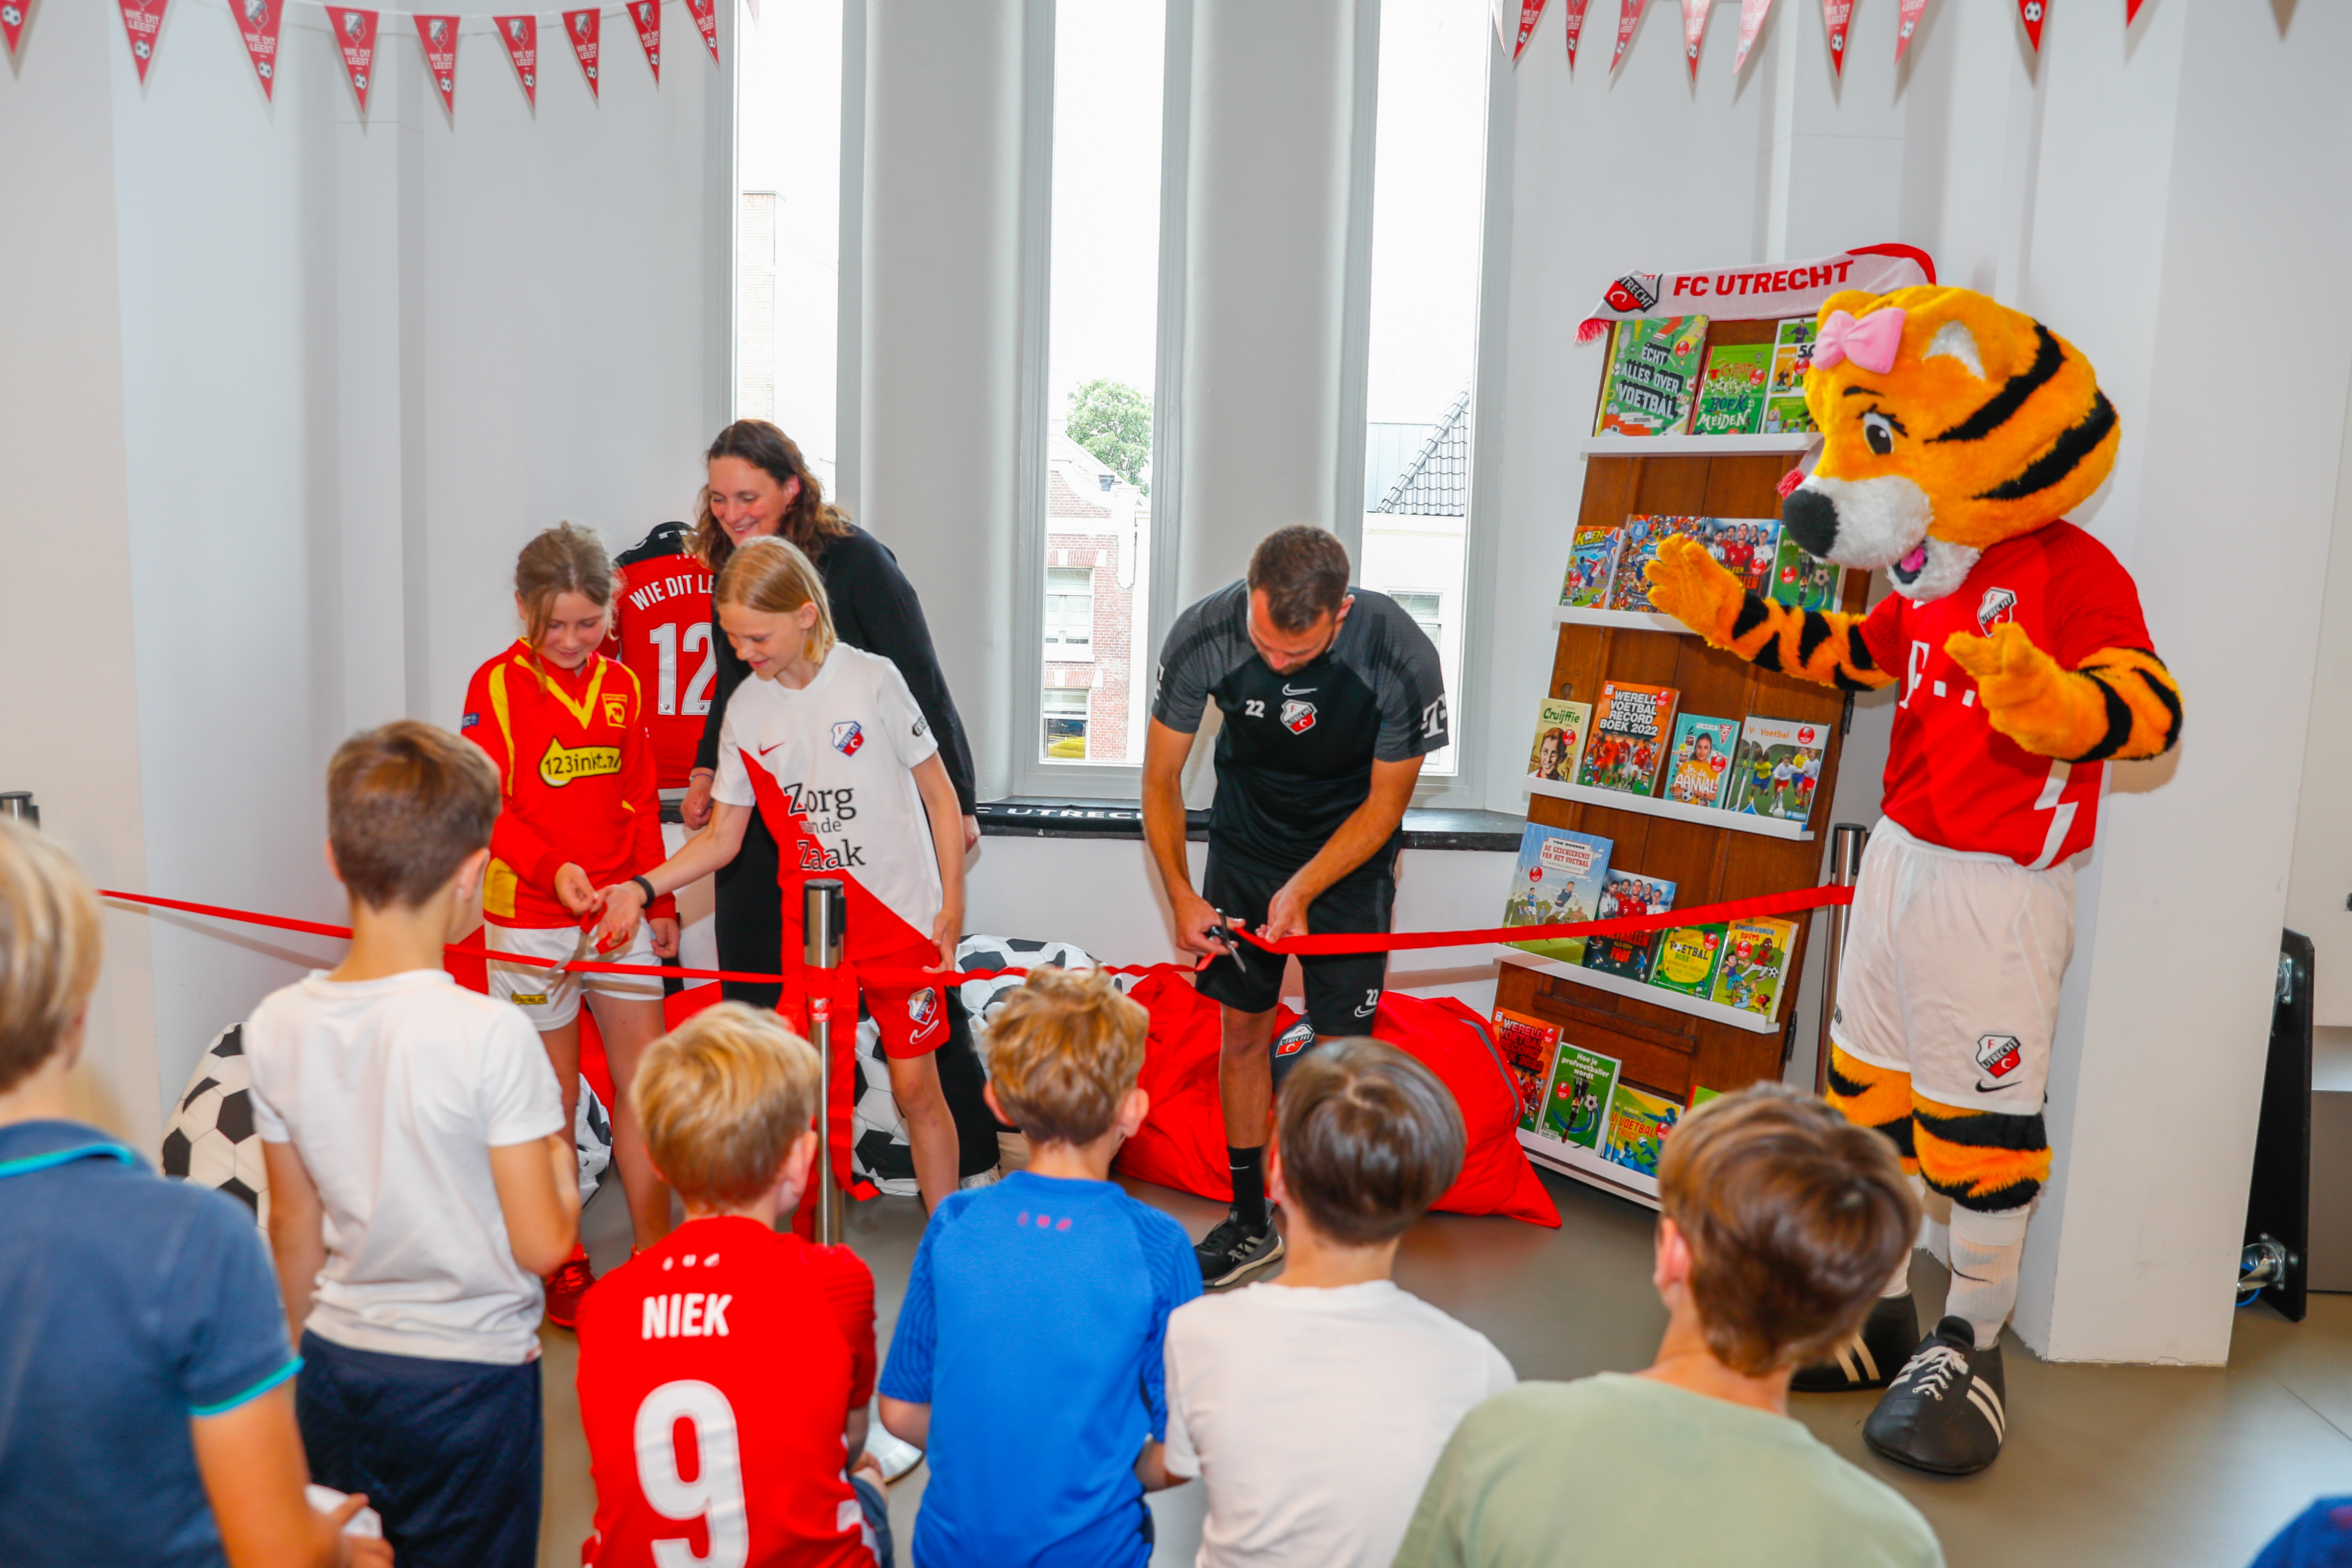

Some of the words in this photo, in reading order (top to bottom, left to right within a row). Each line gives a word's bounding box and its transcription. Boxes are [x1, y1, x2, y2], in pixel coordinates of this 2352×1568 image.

[1827, 6, 1838, 15] WIE
[1839, 4, 1850, 14] DIT
[1902, 0, 1923, 12] LEEST
[125, 9, 143, 21] WIE
[145, 13, 160, 25] DIT
[697, 17, 706, 26] WIE
[1828, 14, 1847, 24] LEEST
[128, 19, 156, 34] LEEST
[701, 22, 715, 32] LEEST
[245, 33, 261, 44] WIE
[262, 36, 275, 46] DIT
[642, 33, 651, 41] WIE
[644, 38, 659, 48] LEEST
[250, 43, 274, 54] LEEST
[344, 48, 358, 57] WIE
[360, 49, 371, 58] DIT
[580, 51, 597, 60] LEEST
[348, 56, 370, 66] LEEST
[430, 54, 442, 62] WIE
[1673, 276, 1709, 297] FC
[1715, 260, 1854, 296] UTRECHT
[1641, 345, 1668, 366] ECHT
[1621, 363, 1652, 384] ALLES
[1653, 373, 1680, 394] OVER
[1720, 362, 1756, 379] GROT
[1619, 383, 1675, 420] VOETBAL
[1706, 394, 1749, 412] BOEK
[1574, 530, 1605, 546] KOEN
[629, 581, 666, 610] WIE
[665, 574, 693, 597] DIT
[1981, 597, 2011, 625] UTRECHT
[649, 622, 718, 716] 12
[1614, 690, 1657, 705] WERELD
[1245, 699, 1266, 719] 22
[1543, 707, 1580, 724] Cruijffie
[1610, 699, 1657, 716] VOETBAL
[1608, 709, 1654, 725] RECORD
[1599, 718, 1630, 733] BOEK
[1630, 723, 1659, 736] 2022
[1760, 728, 1790, 739] Voetbal
[784, 782, 858, 821] Zorg
[799, 820, 820, 834] van
[821, 817, 842, 834] de
[797, 839, 867, 871] Zaak
[1553, 846, 1591, 860] GESCHIEDENIS
[1553, 854, 1565, 862] HET
[1565, 857, 1589, 868] VOETBAL
[1610, 947, 1632, 963] PROF
[1670, 941, 1708, 961] VOETBAL
[1365, 988, 1379, 1006] 22
[1503, 1018, 1544, 1040] WERELD
[1500, 1027, 1543, 1051] VOETBAL
[1577, 1052, 1590, 1063] Hoe
[1590, 1057, 1598, 1066] je
[1981, 1038, 2018, 1069] UTRECHT
[1518, 1055, 1544, 1072] 2022
[1561, 1057, 1610, 1078] profvoetballer
[1574, 1068, 1594, 1080] wordt
[1618, 1127, 1638, 1141] TRUCS
[1619, 1116, 1655, 1138] VOETBAL
[641, 1293, 733, 1341] NIEK
[633, 1378, 750, 1568] 9
